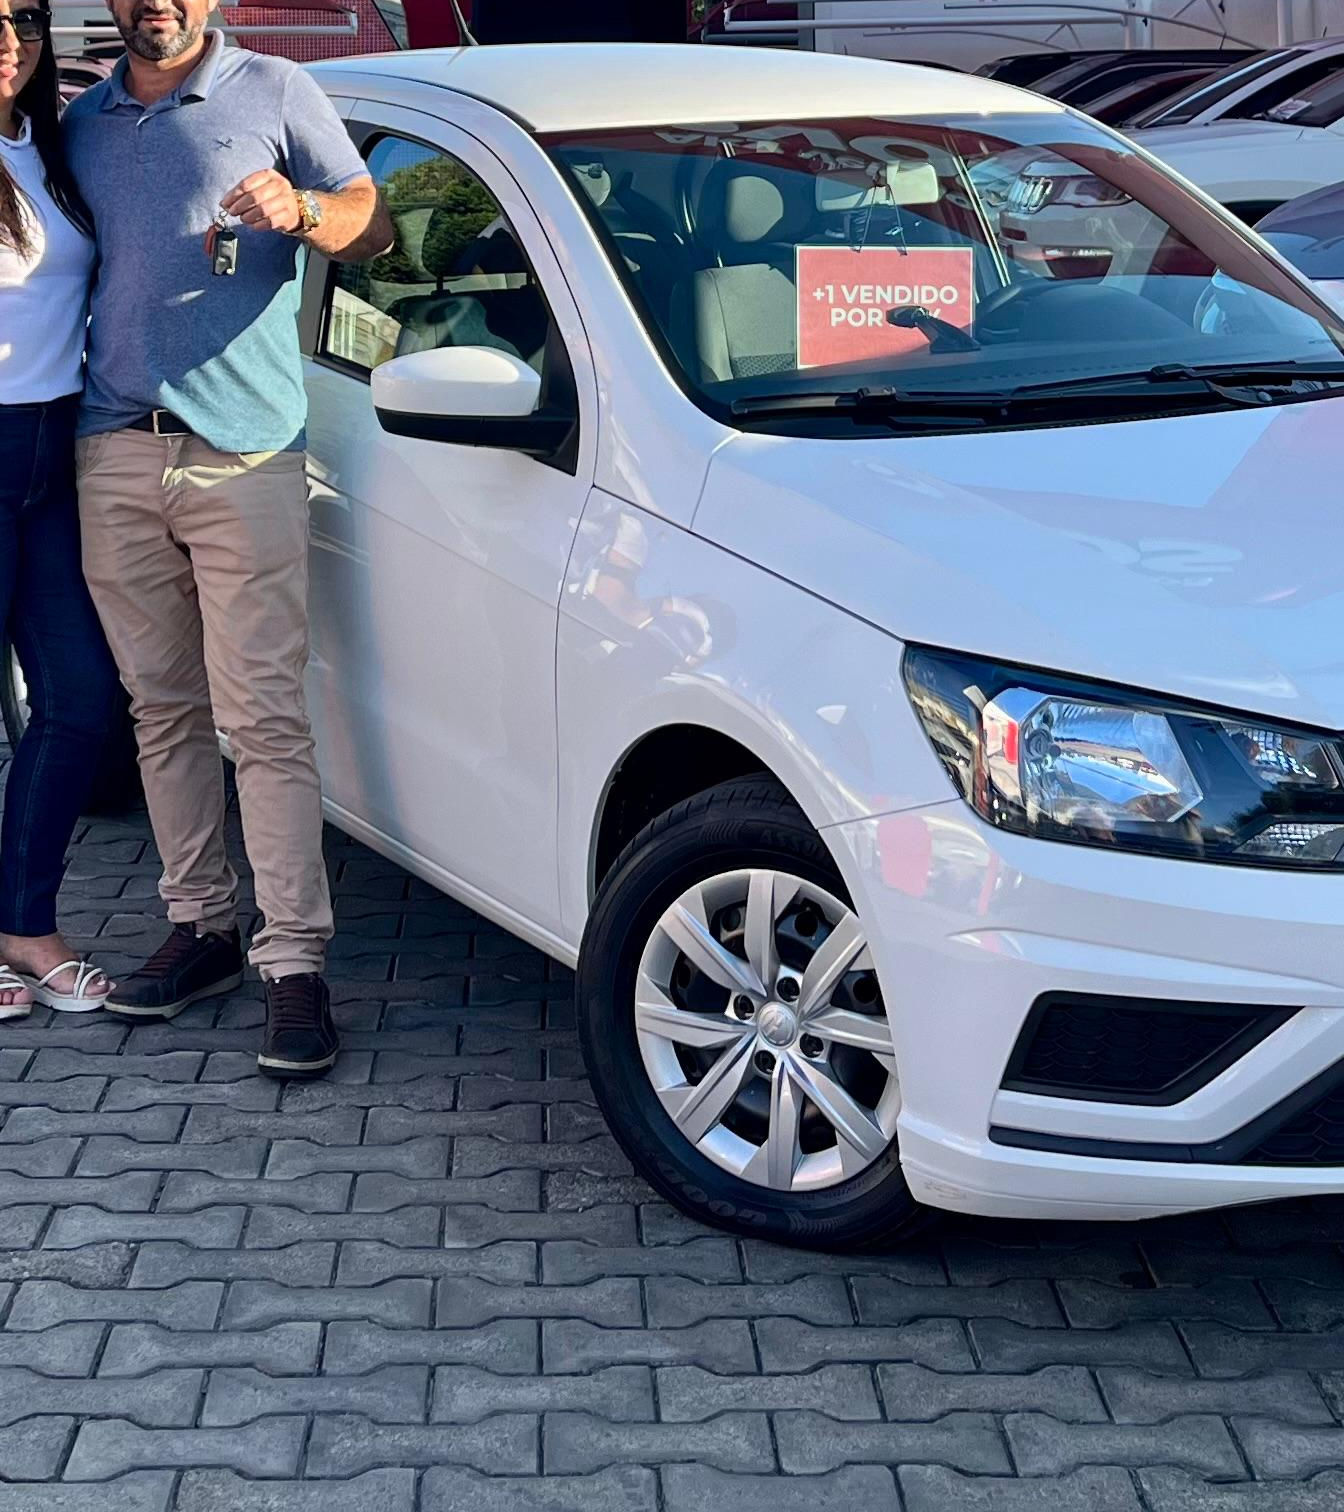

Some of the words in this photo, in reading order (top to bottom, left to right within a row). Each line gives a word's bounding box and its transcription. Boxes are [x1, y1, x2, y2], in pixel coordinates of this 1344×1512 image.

[813, 285, 834, 305] +1
[841, 285, 959, 305] VENDIDO
[830, 308, 883, 328] POR
